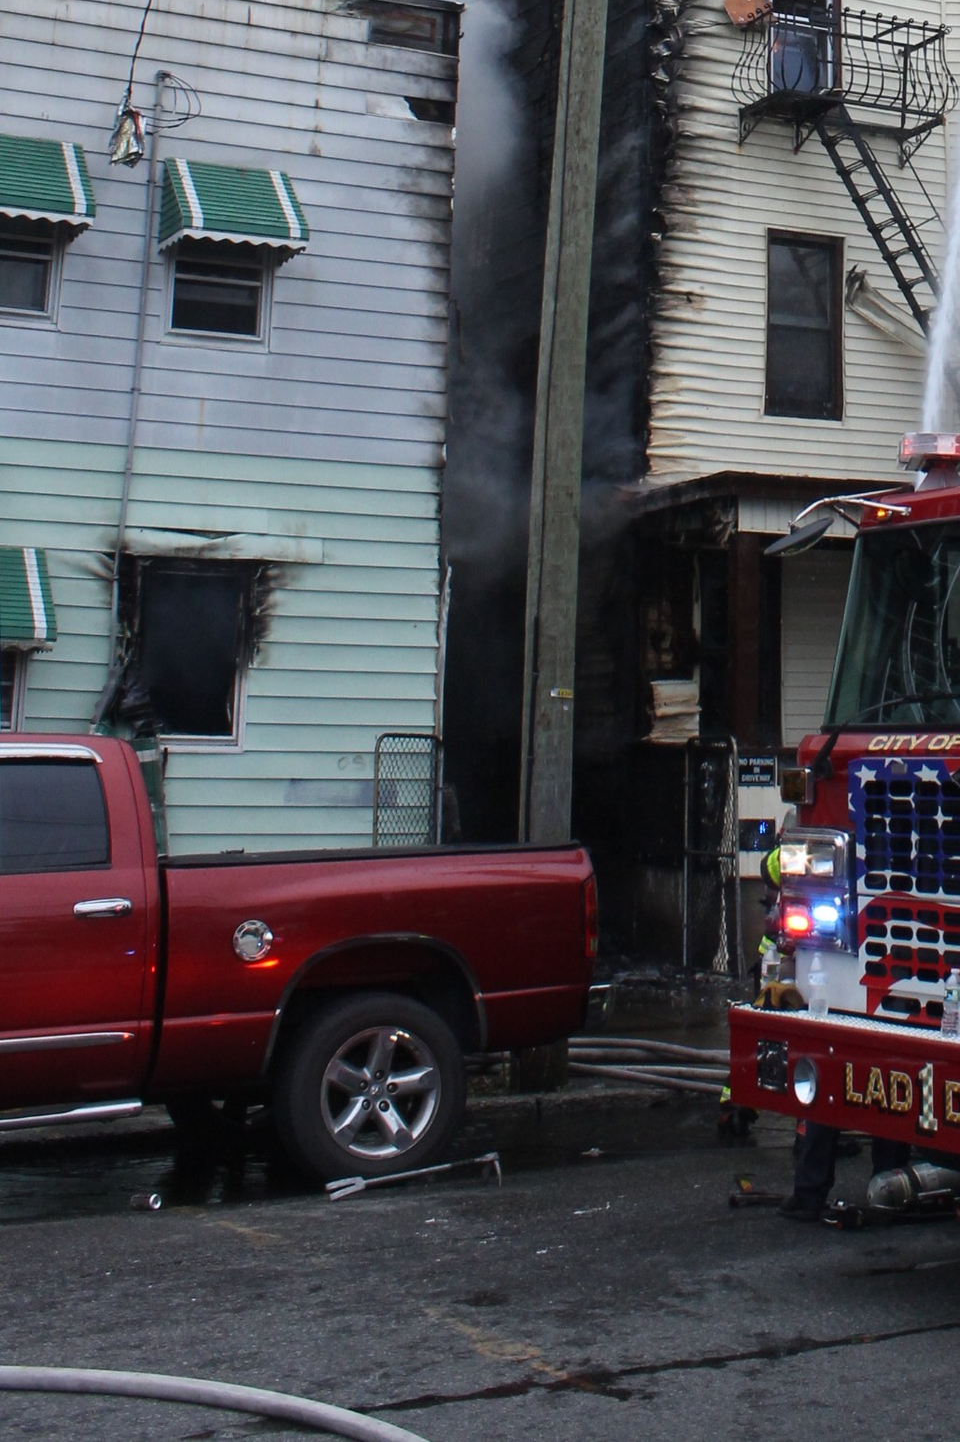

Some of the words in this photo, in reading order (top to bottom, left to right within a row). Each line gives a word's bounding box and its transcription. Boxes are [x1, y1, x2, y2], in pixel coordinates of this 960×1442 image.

[868, 735, 923, 751] CITY
[738, 758, 748, 766] NO
[749, 758, 774, 766] PARKING
[753, 766, 761, 774] IN
[741, 774, 771, 782] DRIVEWAY
